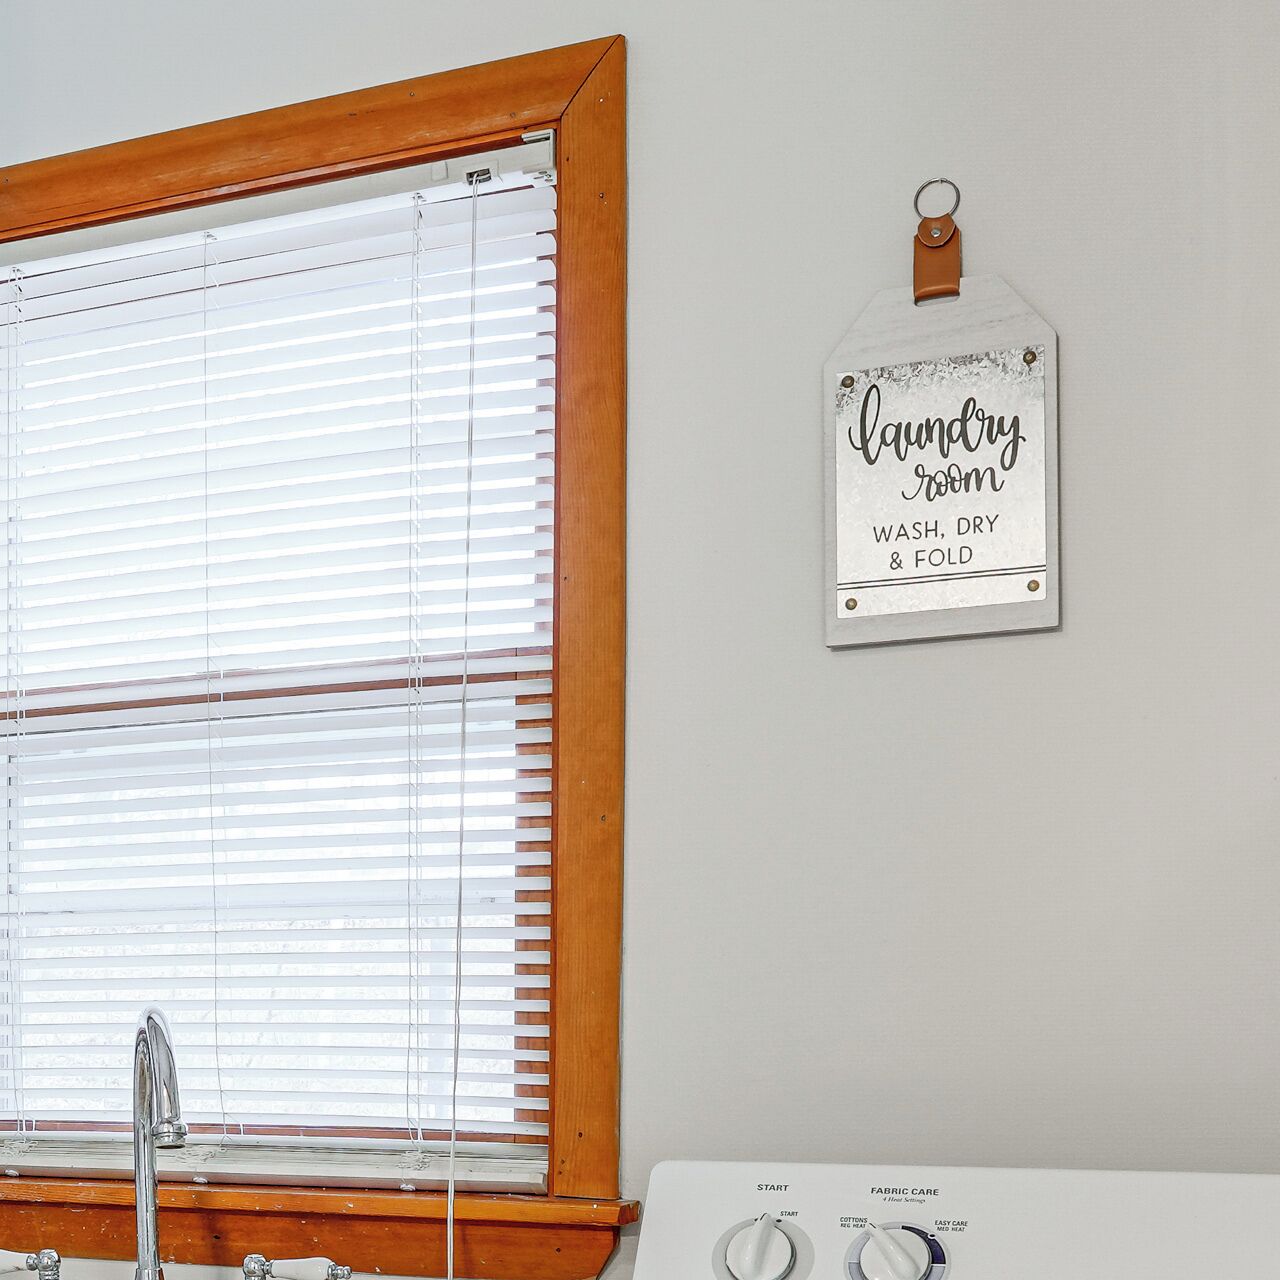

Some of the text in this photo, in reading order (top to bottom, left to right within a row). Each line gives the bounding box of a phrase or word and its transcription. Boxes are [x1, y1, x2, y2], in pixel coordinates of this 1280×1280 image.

[848, 383, 1026, 471] laundry
[902, 463, 1005, 501] room
[873, 514, 999, 543] WASH, DRY
[889, 545, 973, 570] & FOLD
[756, 1183, 789, 1191] START
[870, 1187, 939, 1196] FABRIC CARE
